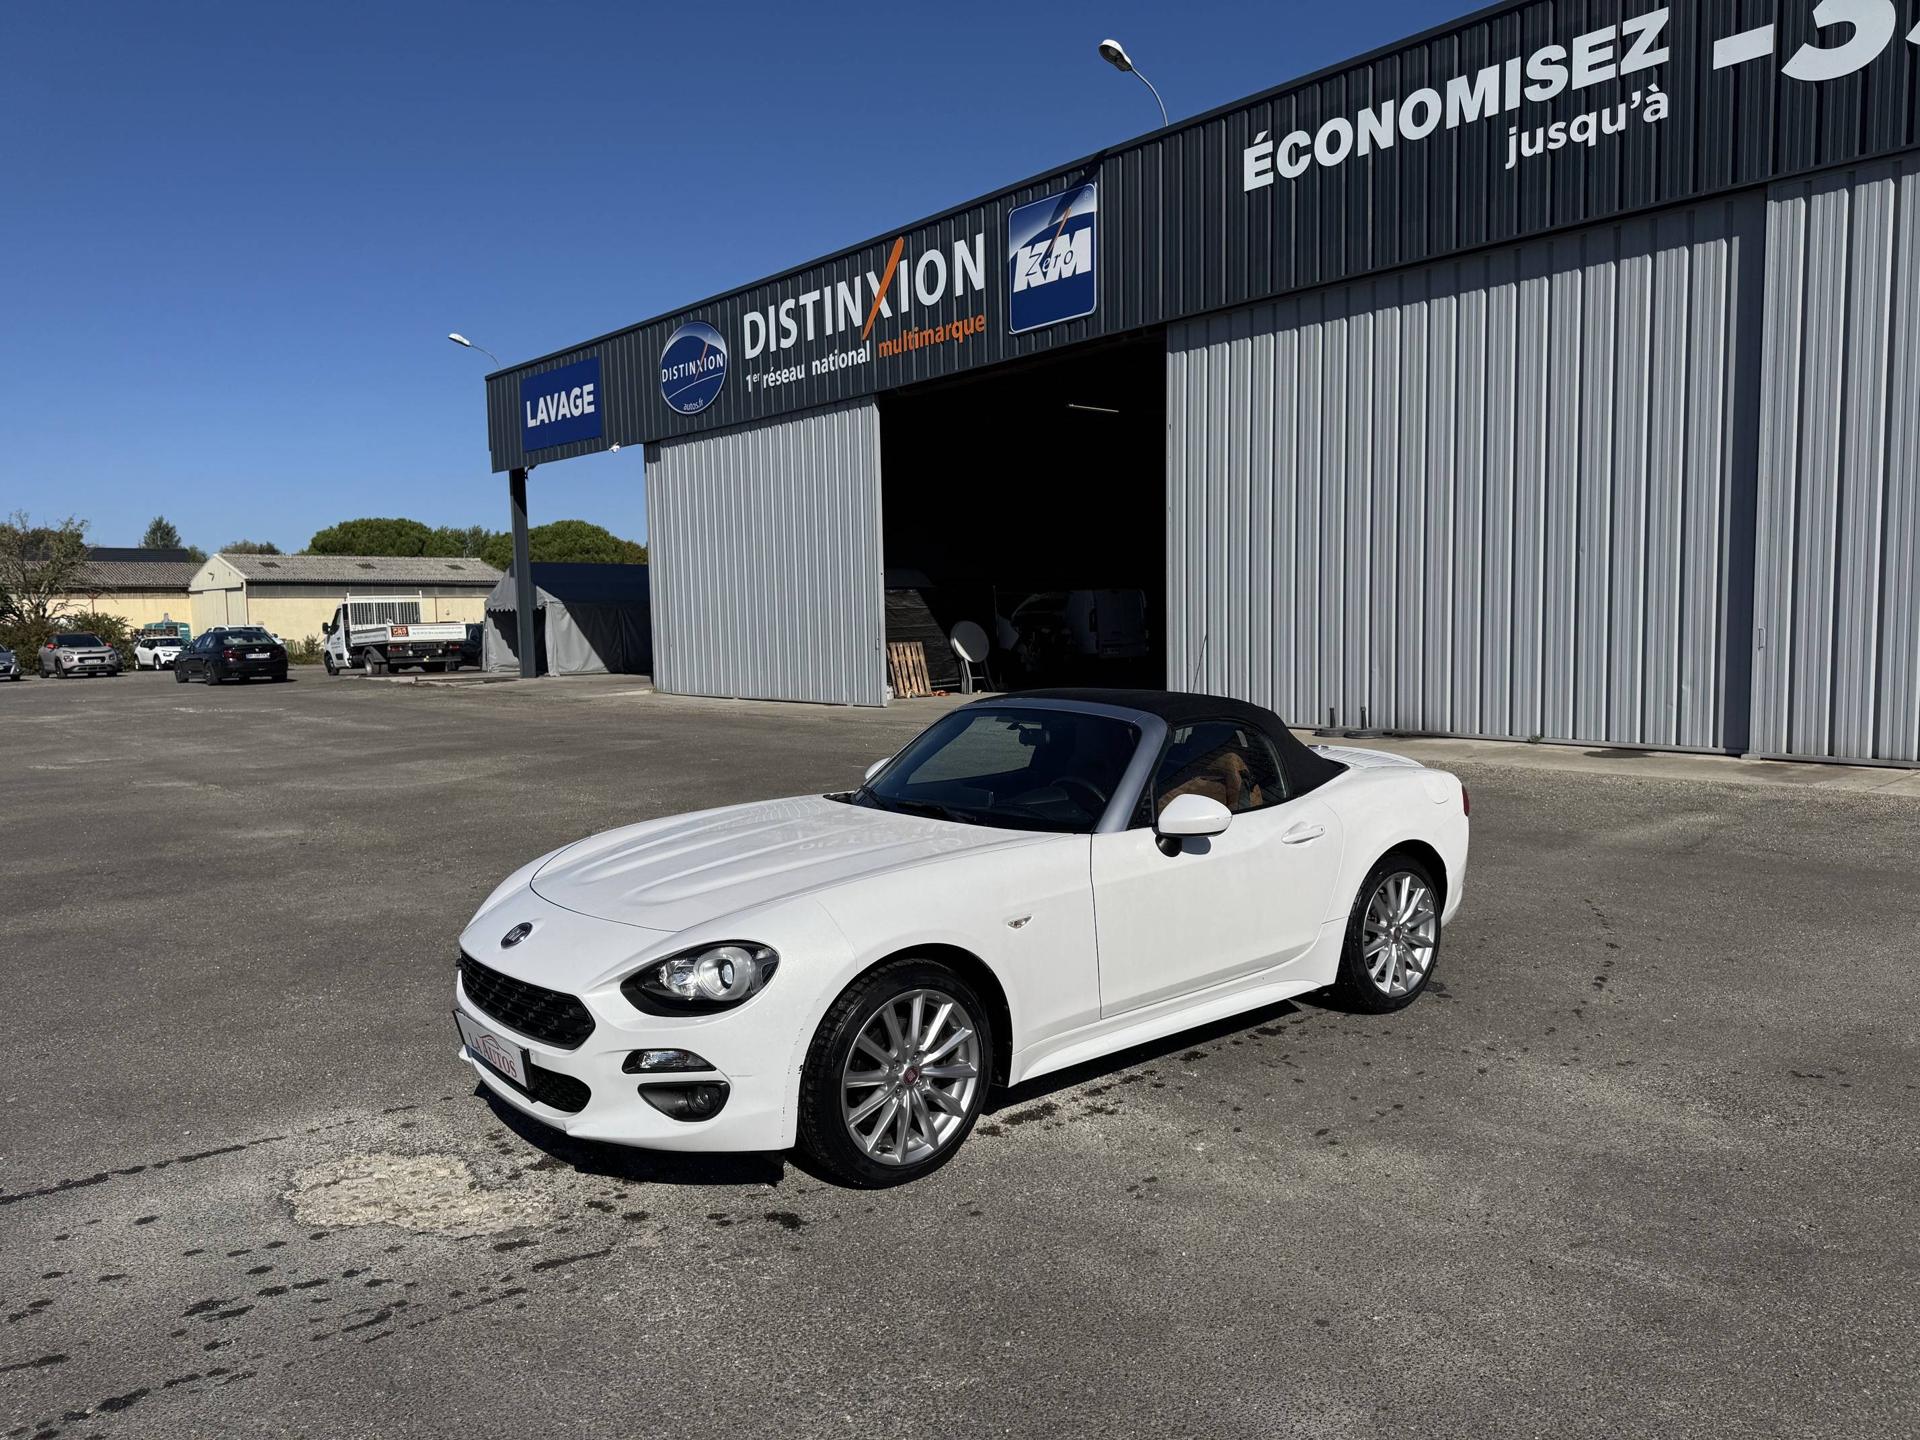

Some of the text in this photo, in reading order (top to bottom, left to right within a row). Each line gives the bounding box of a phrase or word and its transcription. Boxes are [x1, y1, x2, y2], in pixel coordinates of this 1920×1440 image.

[1243, 6, 1669, 192] ÉCONOMISEZ
[1505, 83, 1669, 170] jusqu’à
[1013, 227, 1091, 293] KM
[743, 233, 985, 360] DISTINXION
[661, 346, 724, 383] DISTINXION
[763, 363, 806, 389] réseau
[812, 341, 871, 376] national
[879, 314, 985, 358] multimarque
[526, 383, 595, 428] LAVAGE
[683, 398, 704, 411] autos.fr
